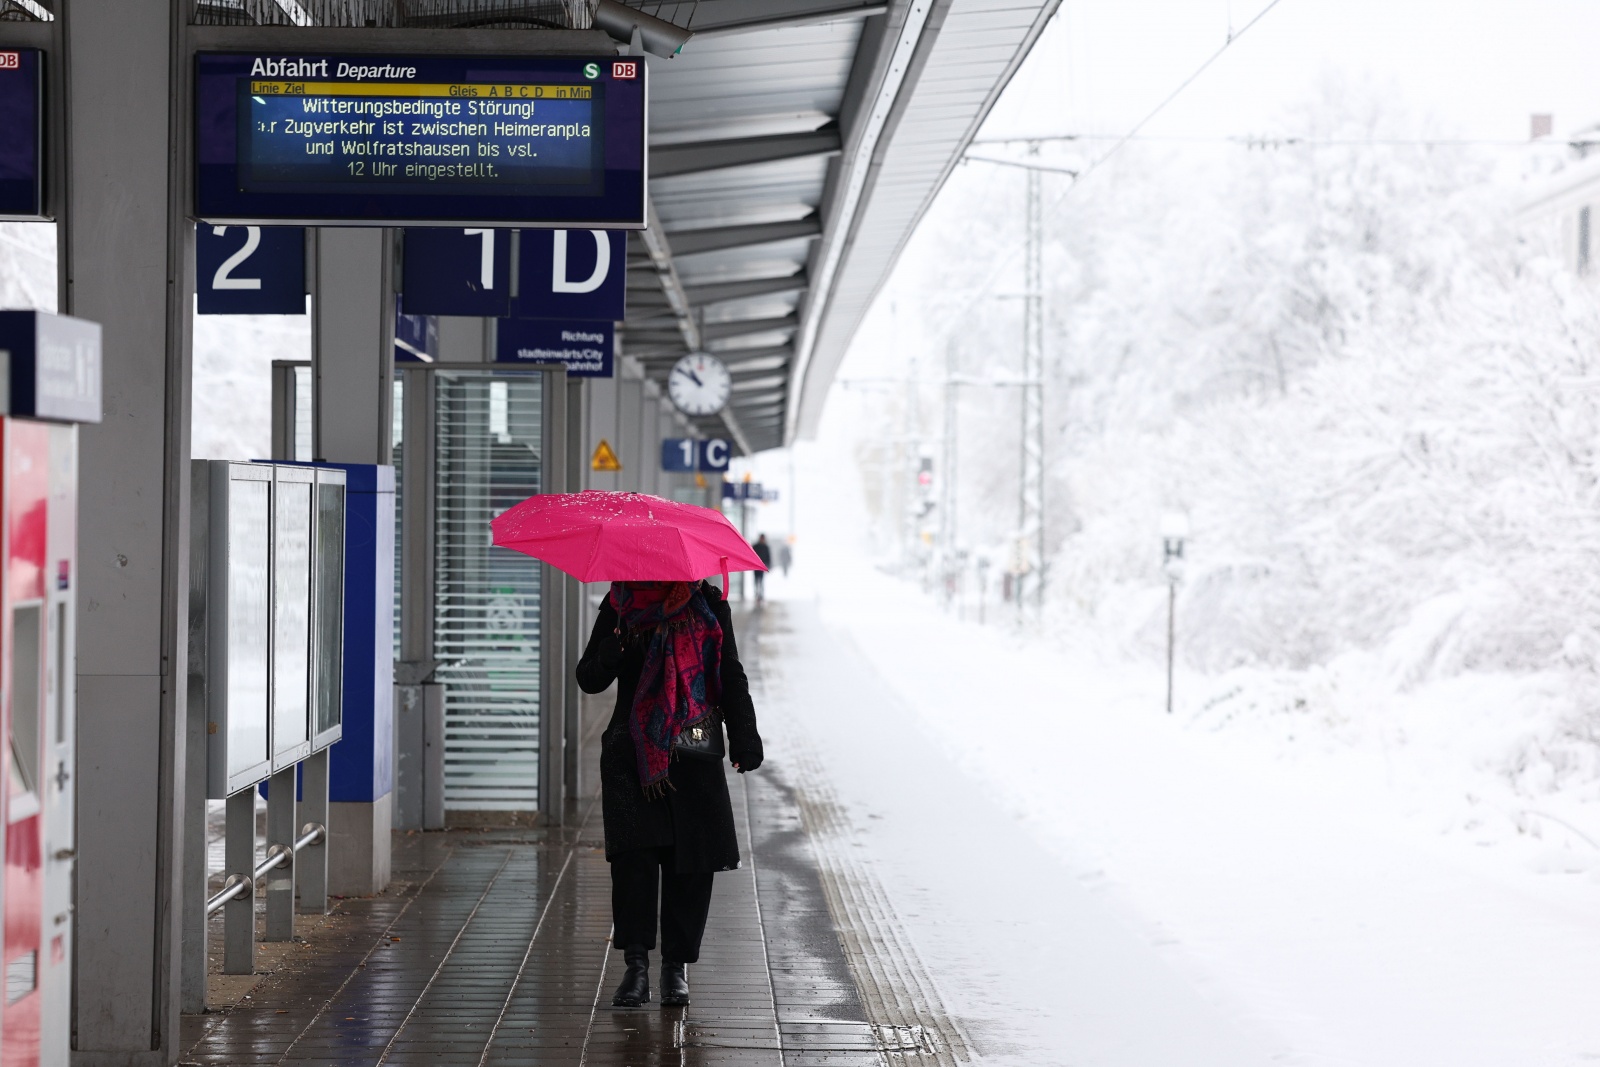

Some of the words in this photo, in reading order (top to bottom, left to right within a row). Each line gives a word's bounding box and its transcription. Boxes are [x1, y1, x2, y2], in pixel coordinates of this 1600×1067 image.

[250, 57, 329, 78] Abfahrt
[336, 62, 417, 81] Departure
[584, 63, 599, 79] S
[614, 63, 635, 78] DB
[252, 82, 280, 94] Linie
[284, 82, 306, 94] Ziel
[449, 85, 478, 97] Gleis
[489, 86, 498, 97] A
[504, 86, 513, 97] B
[519, 86, 528, 97] C
[535, 86, 544, 97] D
[556, 86, 566, 98] in
[570, 87, 591, 98] Min
[302, 98, 461, 118] Witterungsbedingte
[468, 100, 535, 120] Störung!
[284, 119, 376, 138] Zugverkehr
[383, 120, 404, 135] ist
[411, 121, 487, 136] zwischen
[494, 122, 591, 140] Heimeranpla
[305, 141, 334, 155] und
[341, 140, 470, 156] Wolfratshausen
[477, 142, 500, 157] bis
[507, 142, 538, 157] vsl.
[347, 162, 364, 176] 12
[372, 162, 398, 177] Uhr
[405, 162, 499, 181] eingestellt.
[212, 226, 262, 290] 2
[463, 228, 495, 290] 1
[552, 229, 611, 294] D
[561, 330, 604, 344] Richtung
[679, 439, 693, 467] 1
[706, 439, 729, 468] C
